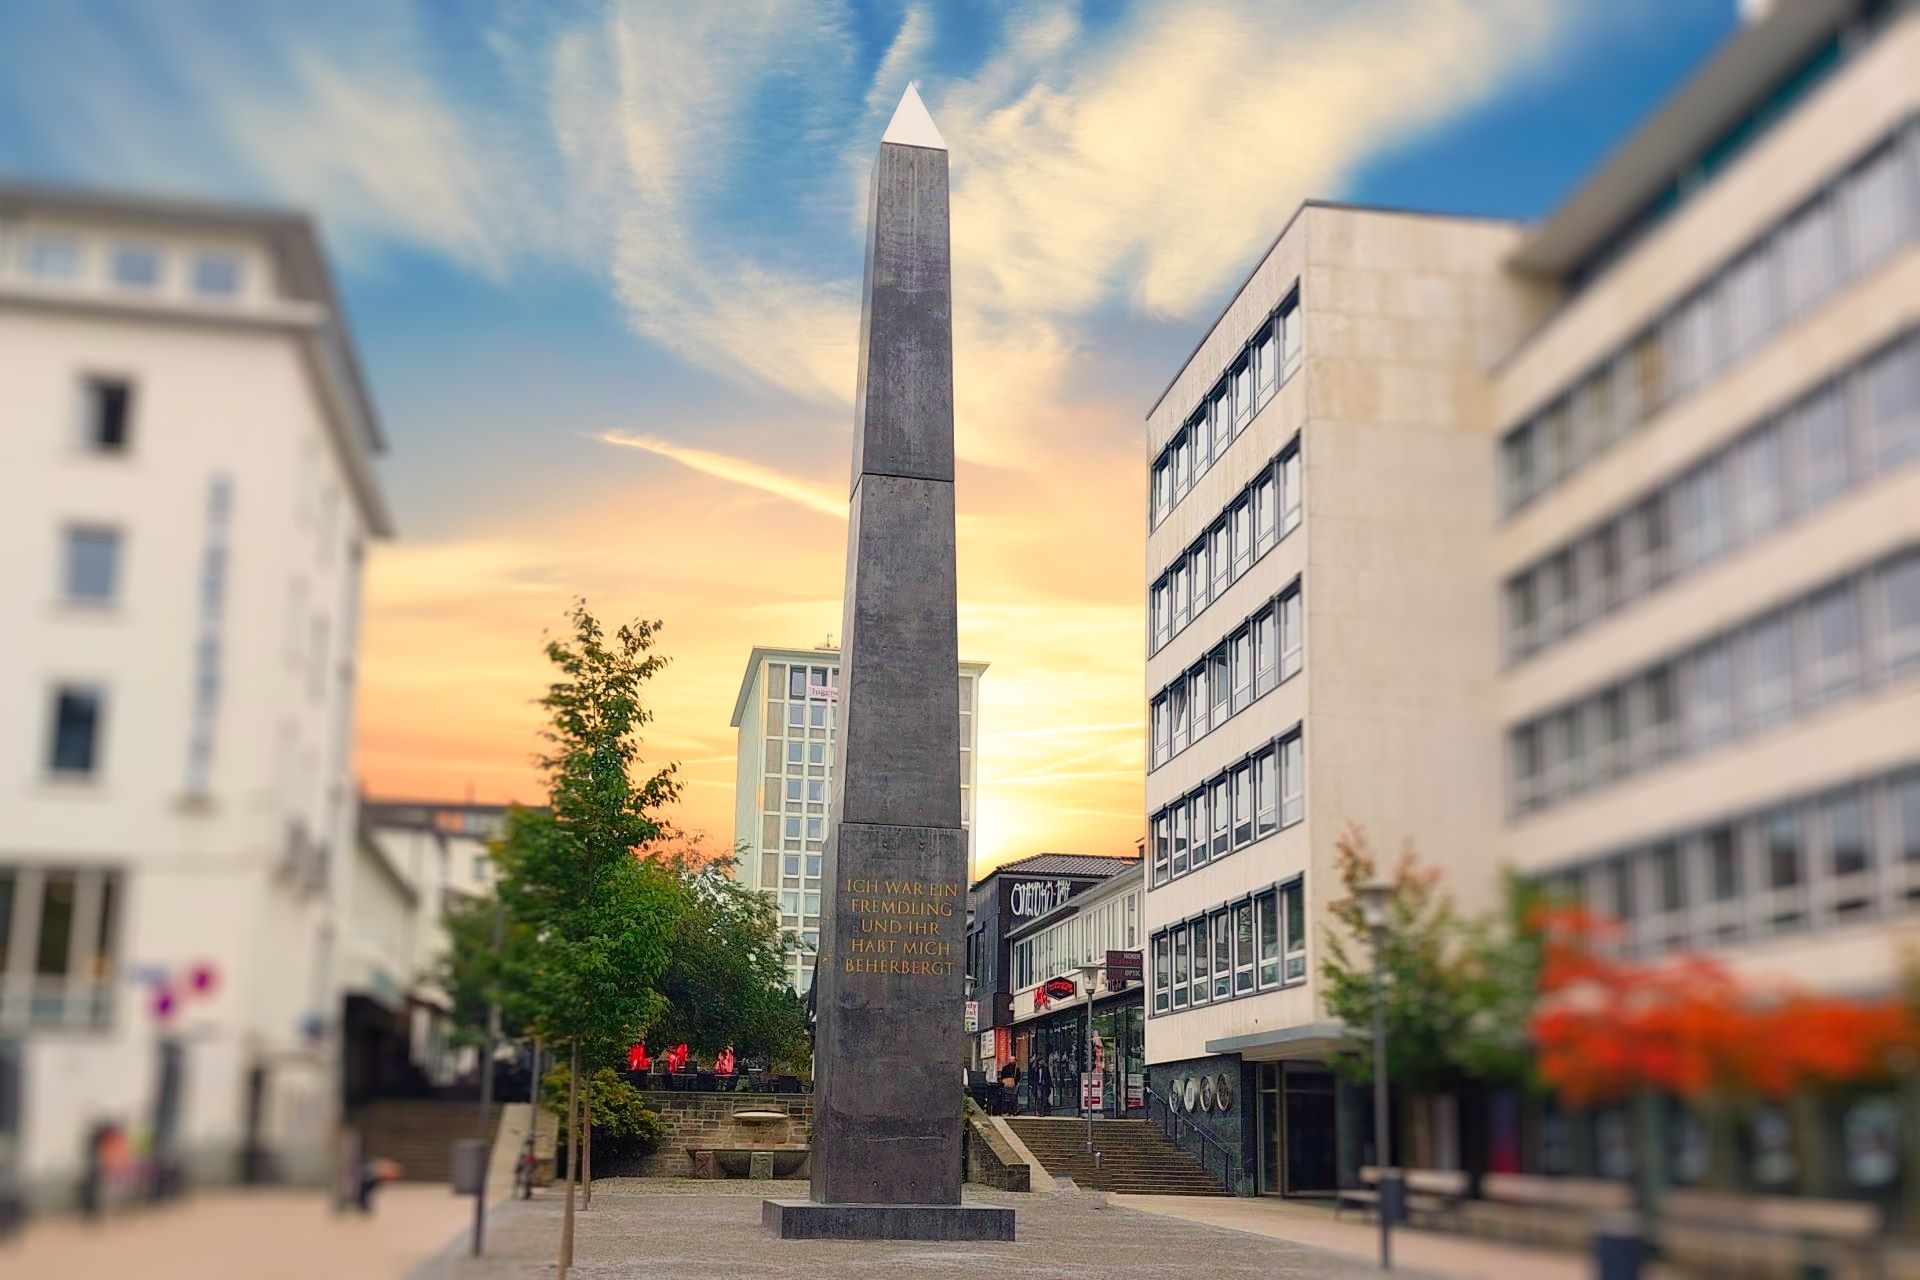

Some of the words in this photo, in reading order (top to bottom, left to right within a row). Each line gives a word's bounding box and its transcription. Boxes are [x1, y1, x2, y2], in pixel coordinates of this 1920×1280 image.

[847, 879, 878, 893] ICH
[885, 881, 923, 895] WAR
[930, 883, 957, 897] EIN
[851, 898, 952, 917] FREMDLING
[862, 919, 902, 934] UND
[908, 921, 940, 936] IHR
[852, 938, 897, 954] HABT
[903, 941, 950, 956] MICH
[845, 958, 955, 976] BEHERBERGT
